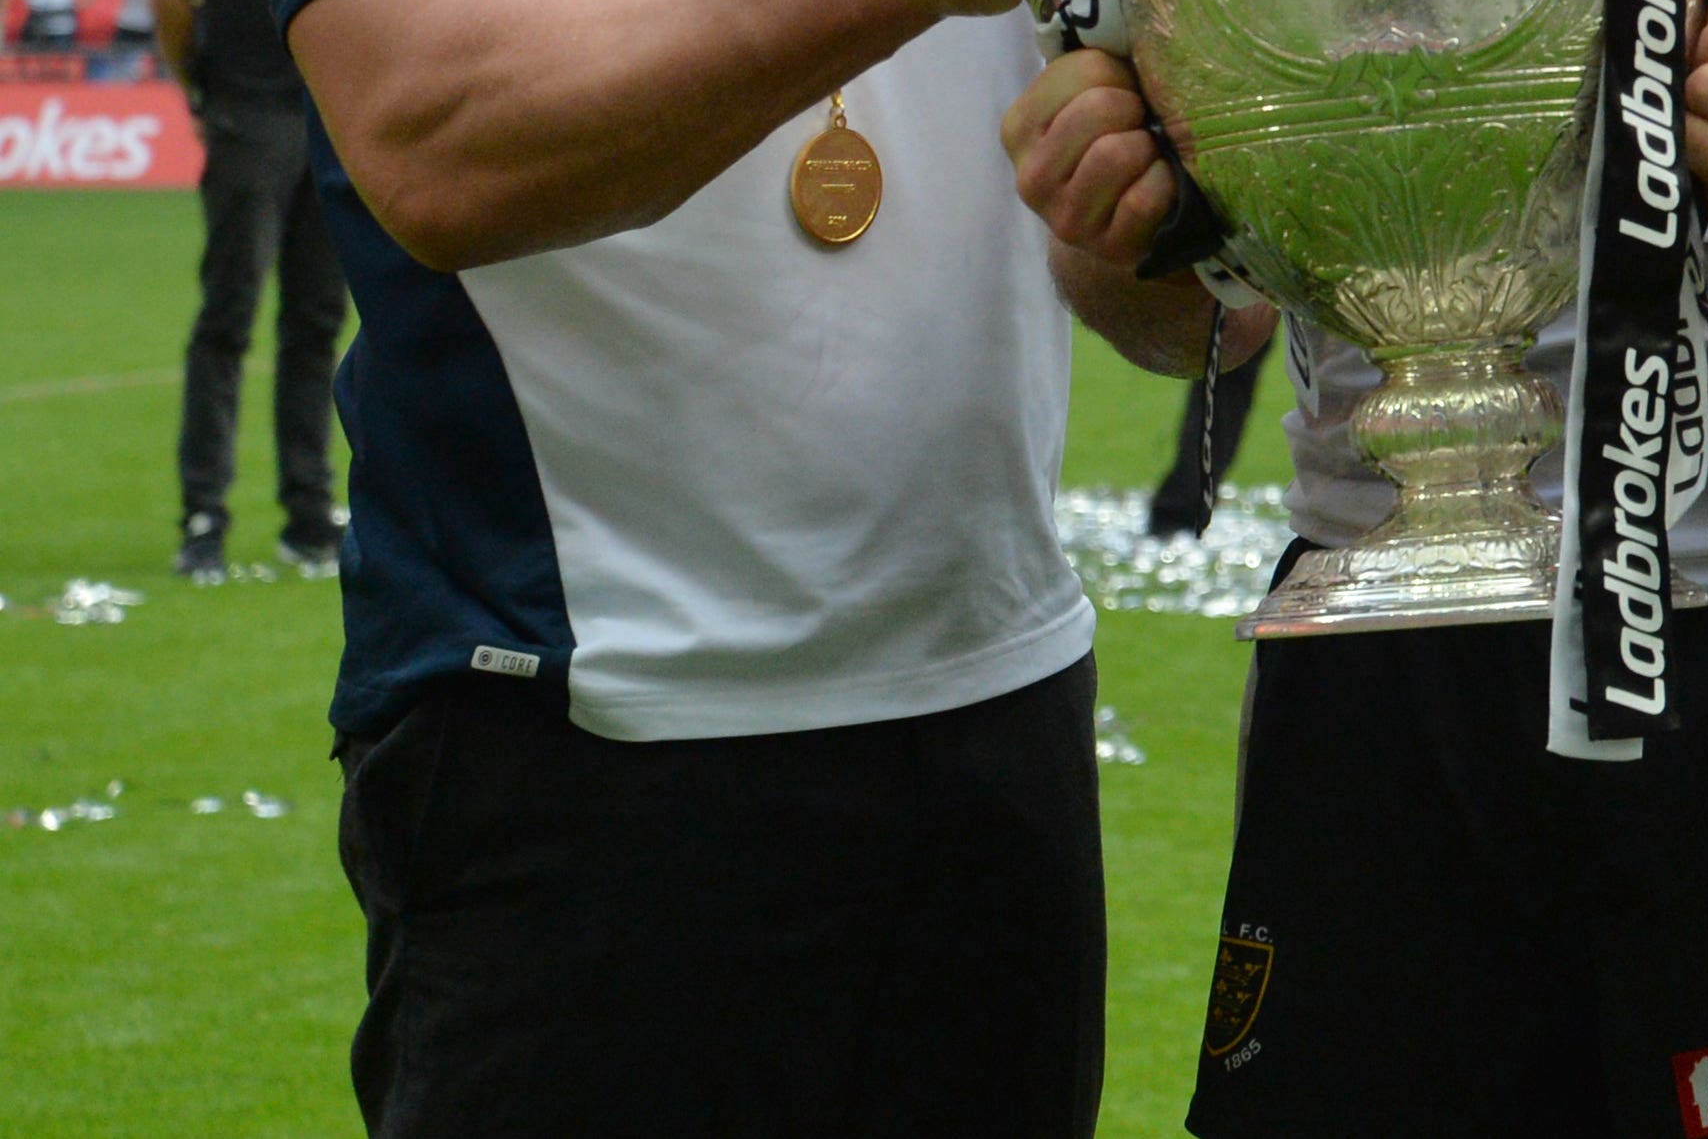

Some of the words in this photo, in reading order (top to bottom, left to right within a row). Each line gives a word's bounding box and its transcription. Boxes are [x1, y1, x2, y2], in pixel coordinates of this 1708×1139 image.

[1602, 346, 1669, 716] Ladbrokes
[501, 655, 533, 673] CORE
[1224, 1038, 1263, 1073] 1865
